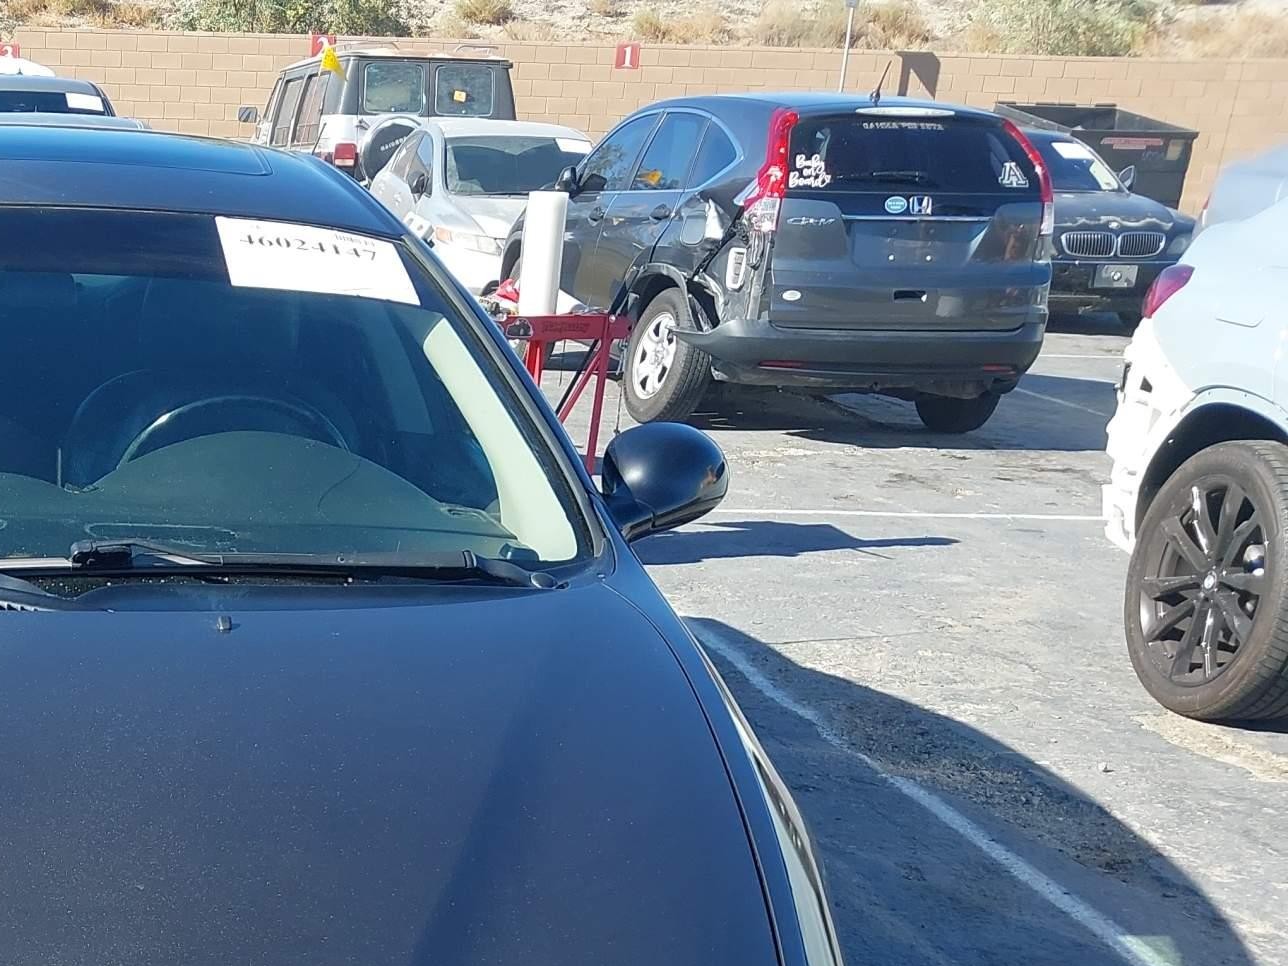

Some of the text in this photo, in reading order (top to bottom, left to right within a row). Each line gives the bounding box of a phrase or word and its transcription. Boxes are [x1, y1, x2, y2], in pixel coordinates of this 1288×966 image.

[621, 46, 633, 69] 1
[795, 153, 825, 174] Baby
[788, 170, 827, 188] Board
[240, 234, 377, 261] 46024147
